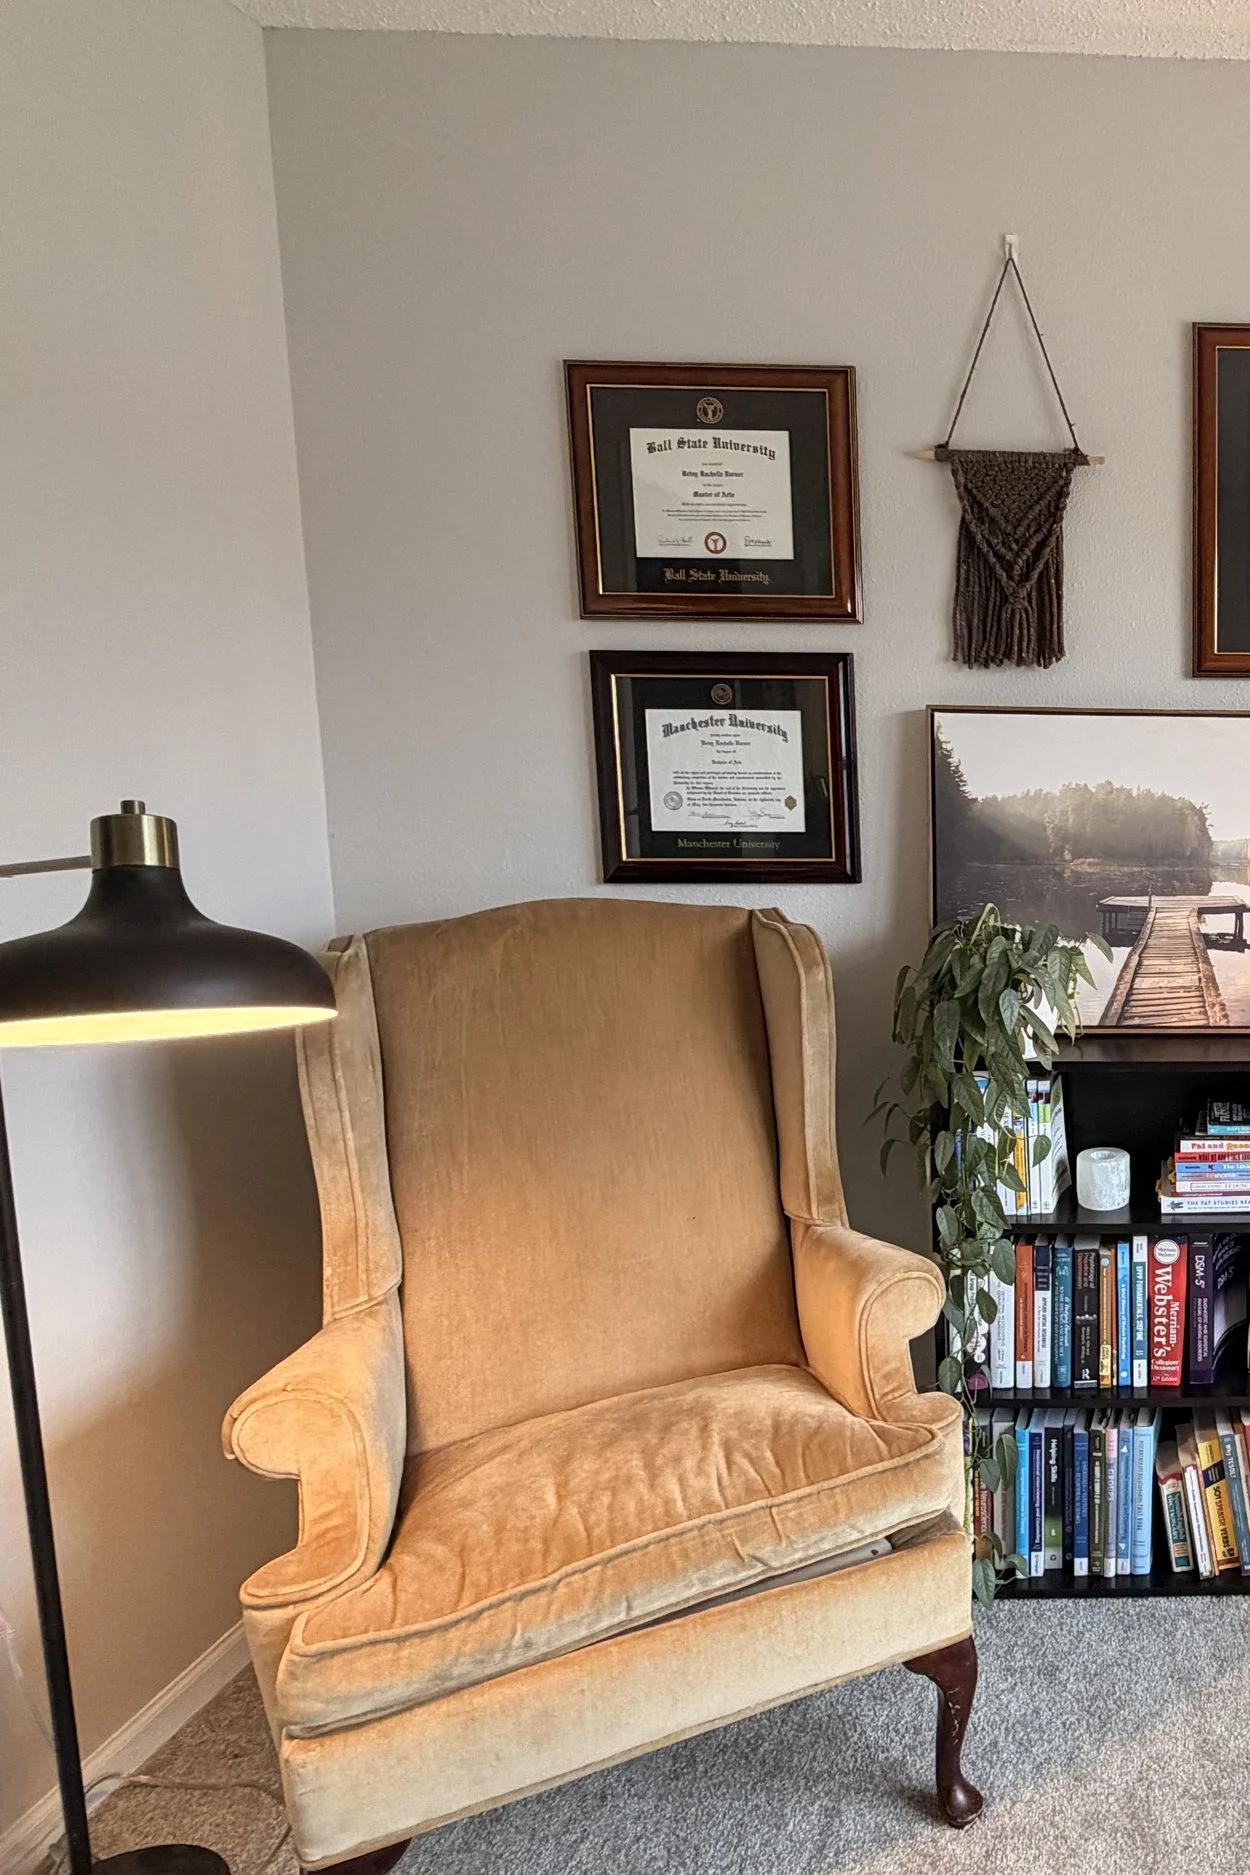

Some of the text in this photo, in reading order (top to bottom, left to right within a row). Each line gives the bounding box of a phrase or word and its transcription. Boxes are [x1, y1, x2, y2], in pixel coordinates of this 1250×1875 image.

[646, 437, 777, 461] Ball State University
[664, 567, 770, 585] Ball State University
[661, 713, 789, 744] Manchester University
[677, 838, 780, 849] Manchester University
[1153, 1265, 1172, 1357] Webster's
[1169, 1301, 1179, 1347] Merriam-
[1049, 1439, 1057, 1464] Helping
[1213, 1486, 1230, 1548] 501 SPANISH VERBS
